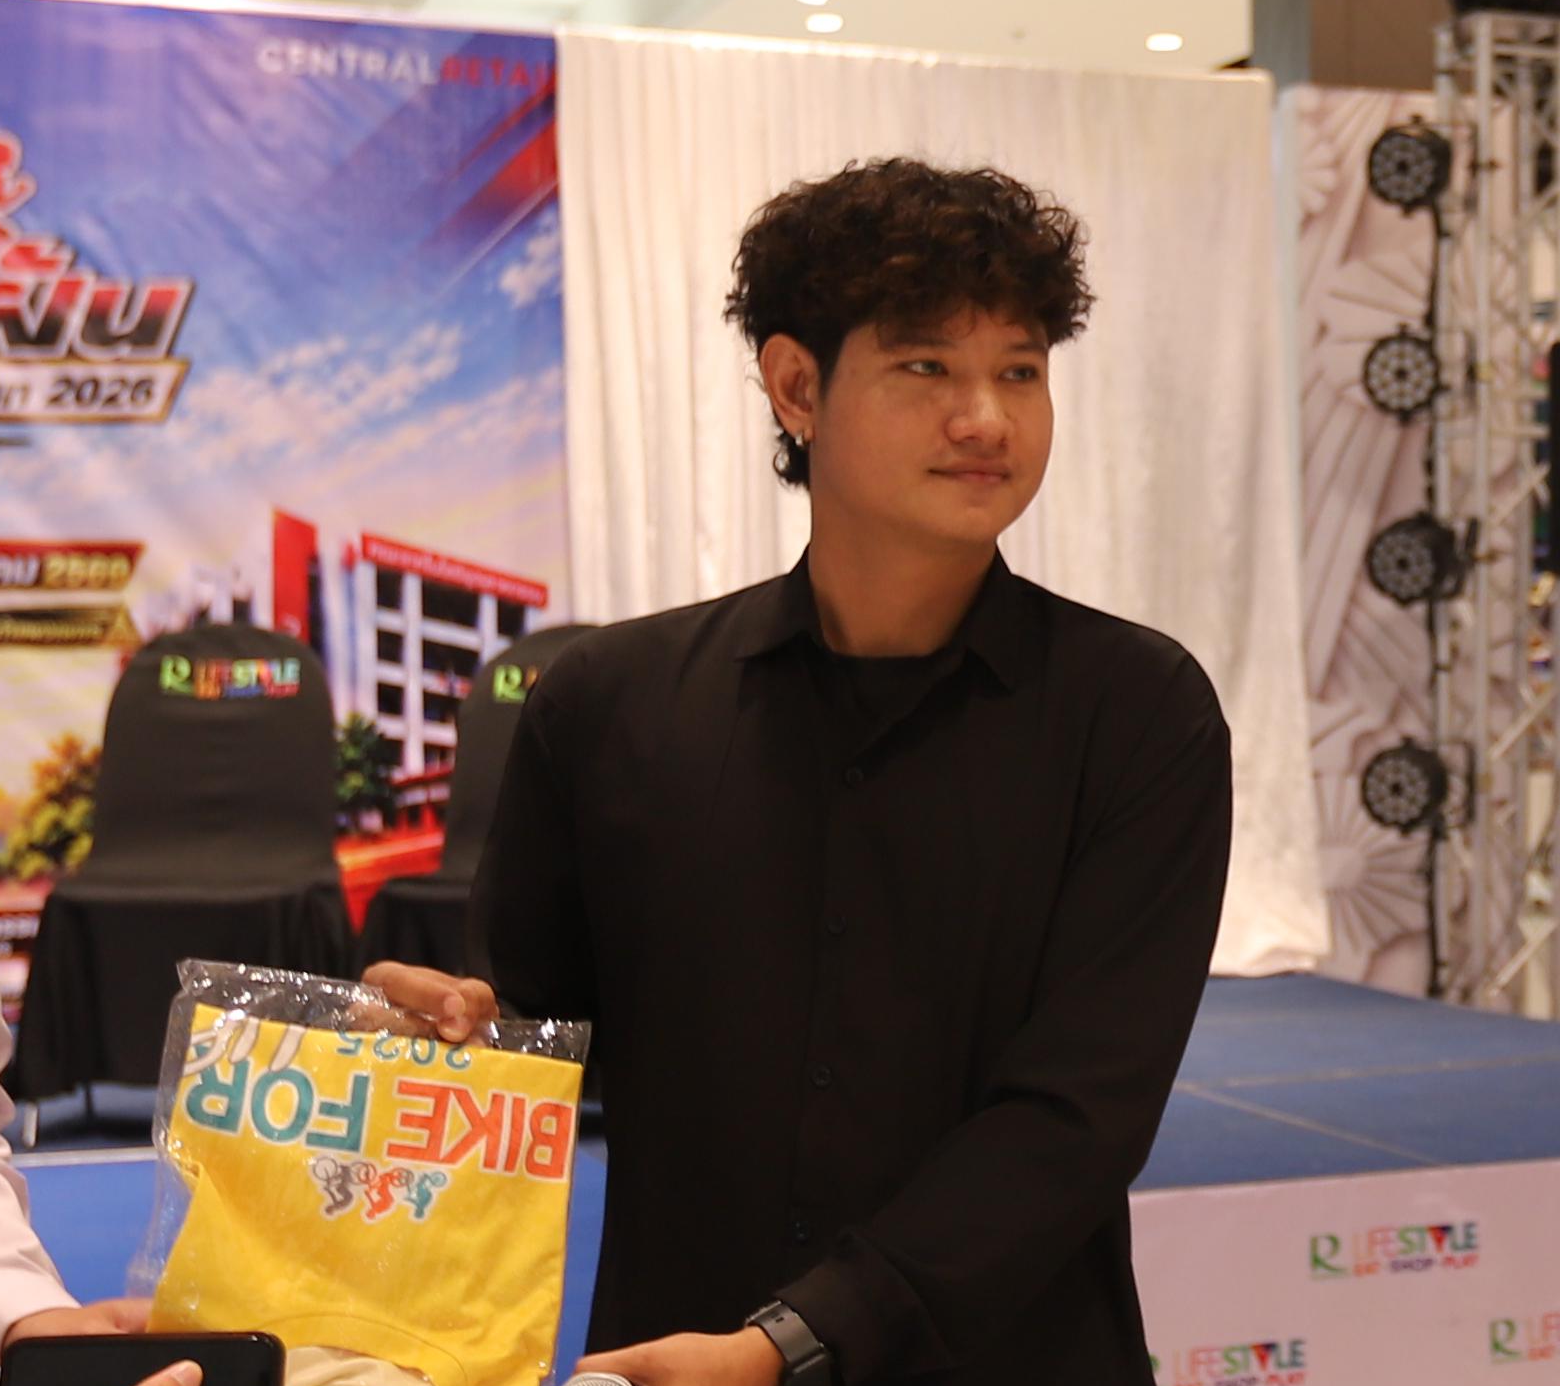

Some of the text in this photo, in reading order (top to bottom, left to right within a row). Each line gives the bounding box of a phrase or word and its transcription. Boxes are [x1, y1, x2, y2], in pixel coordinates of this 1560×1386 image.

[257, 37, 550, 88] CENTRAL RETAI
[44, 376, 155, 406] 2026
[184, 1045, 575, 1180] BIKE FOR
